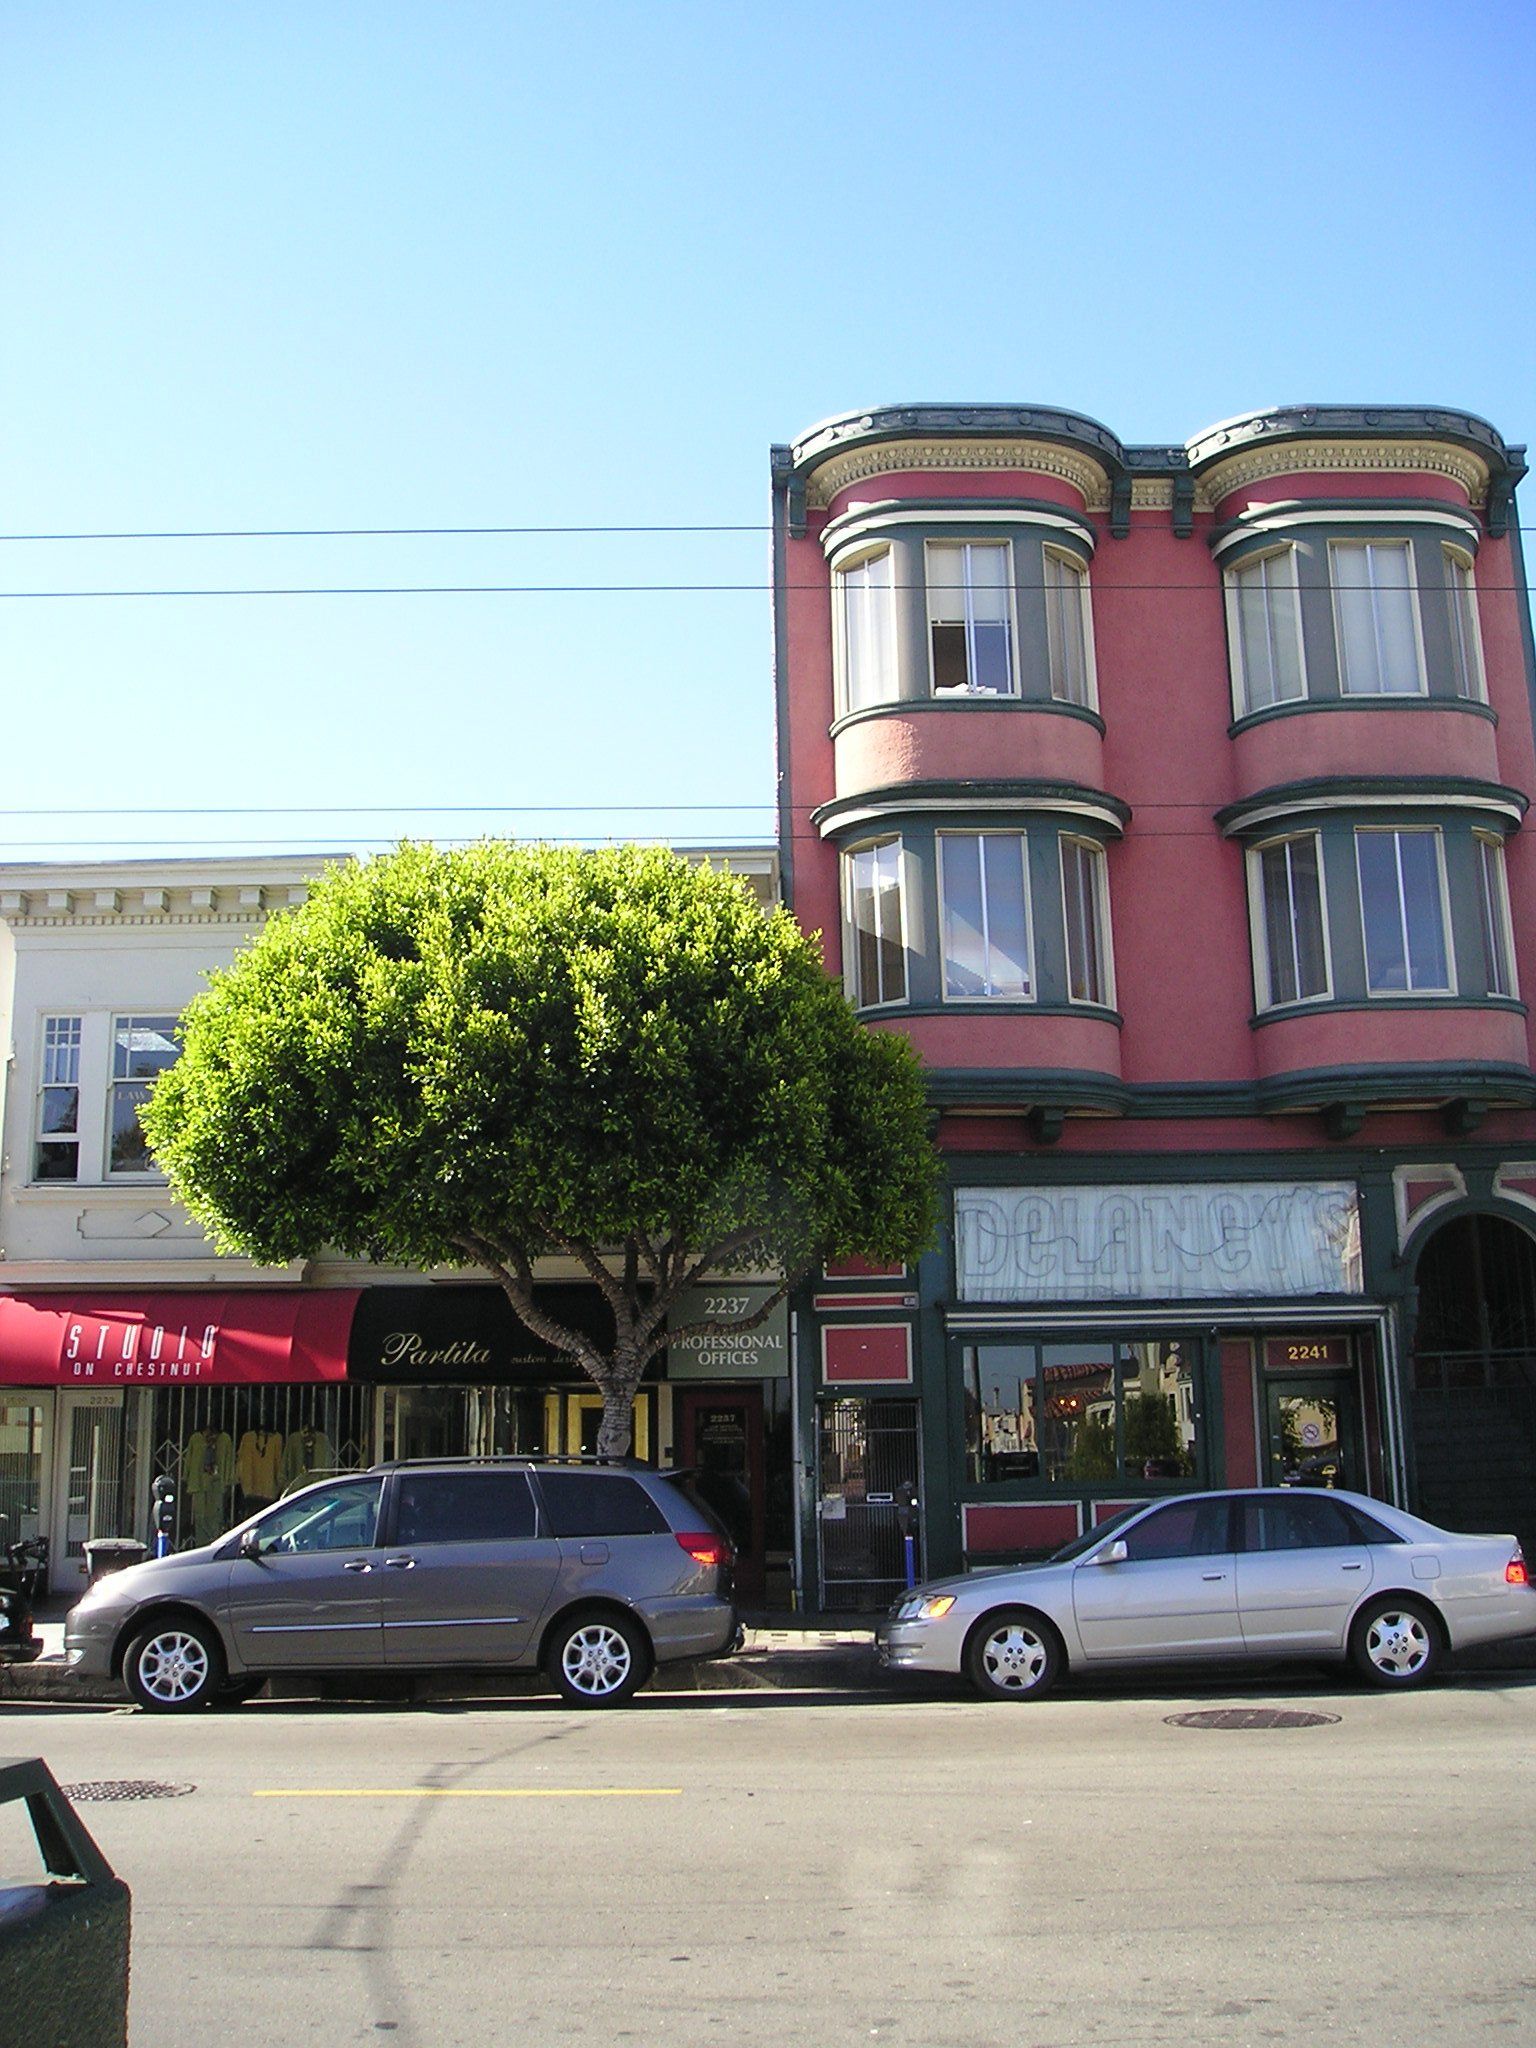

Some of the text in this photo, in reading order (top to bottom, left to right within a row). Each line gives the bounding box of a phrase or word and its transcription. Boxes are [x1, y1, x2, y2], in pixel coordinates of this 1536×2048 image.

[704, 1297, 750, 1314] 2237
[66, 1324, 217, 1360] STUDIO
[381, 1332, 490, 1365] Partita
[698, 1351, 759, 1365] OFFICES
[1288, 1345, 1328, 1361] 2241
[73, 1362, 201, 1376] ON CHESTNUT
